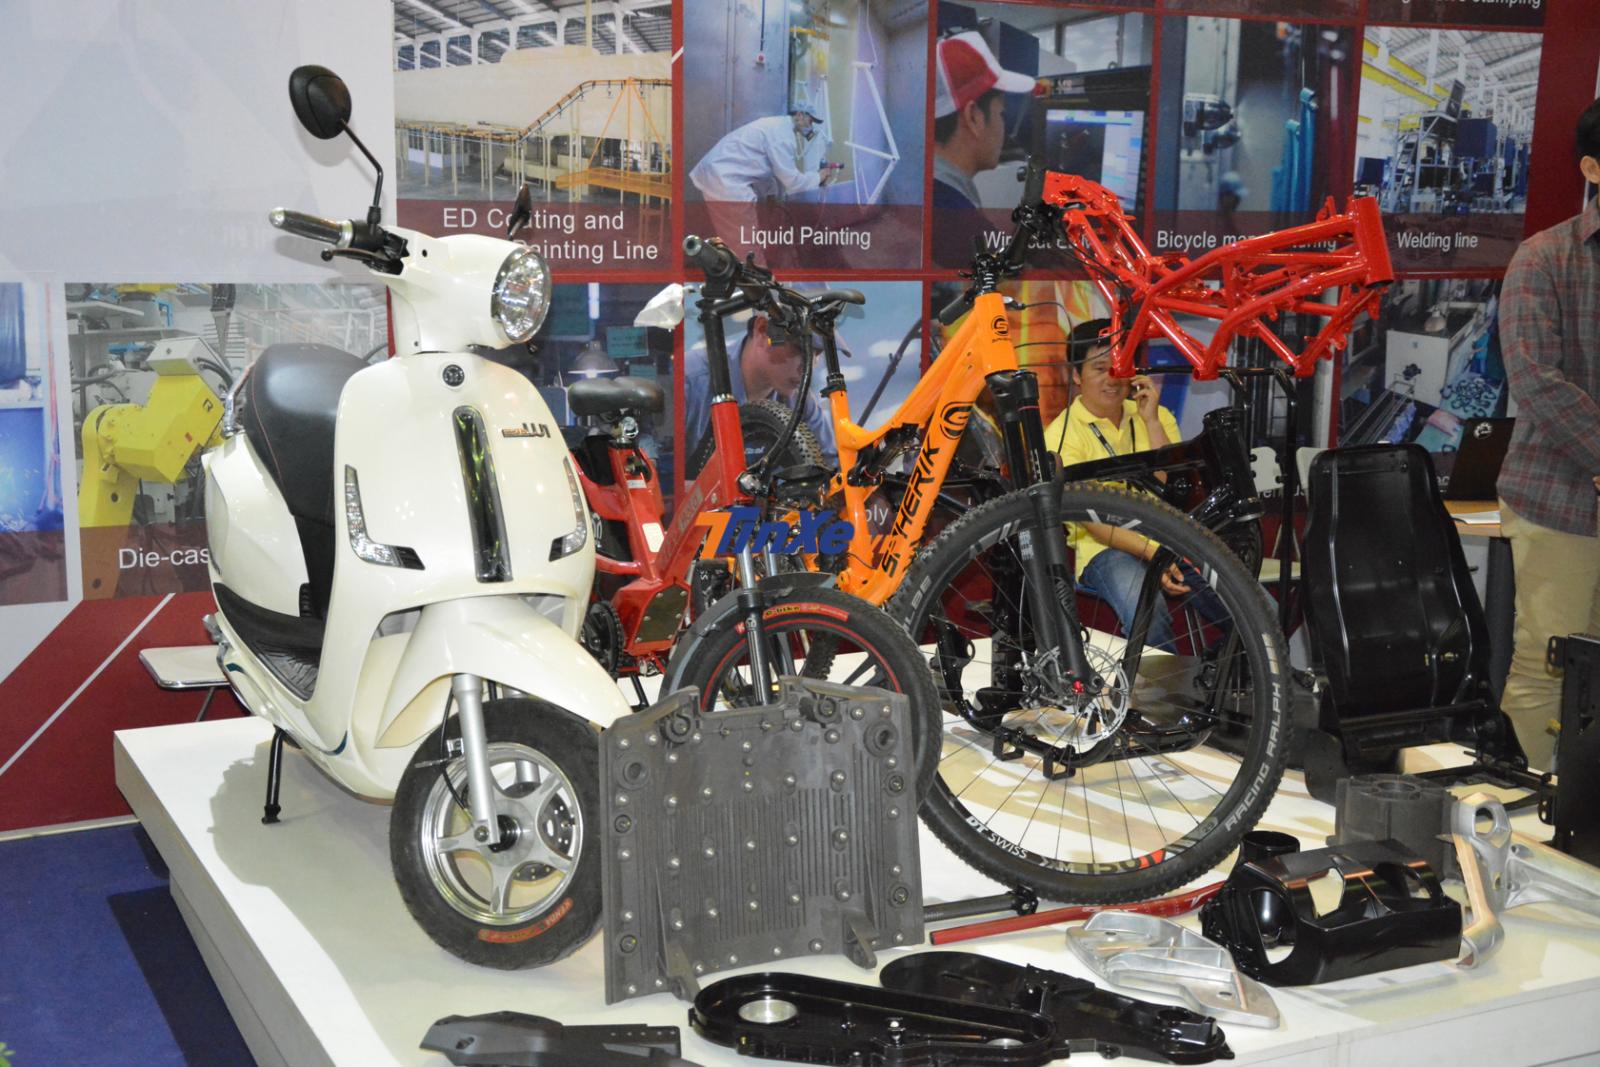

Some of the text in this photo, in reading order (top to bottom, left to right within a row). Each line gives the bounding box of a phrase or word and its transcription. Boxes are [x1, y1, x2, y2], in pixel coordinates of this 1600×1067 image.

[443, 207, 477, 228] ED
[584, 210, 624, 230] and
[740, 225, 871, 250] Liquid Painting
[983, 230, 1013, 249] Wir
[1156, 230, 1217, 252] Bicycle
[1397, 231, 1478, 252] Welding line
[613, 240, 658, 260] Line
[118, 547, 209, 569] Die-cas
[1224, 682, 1282, 832] RACING RALPH
[966, 815, 1029, 860] DT SWISS
